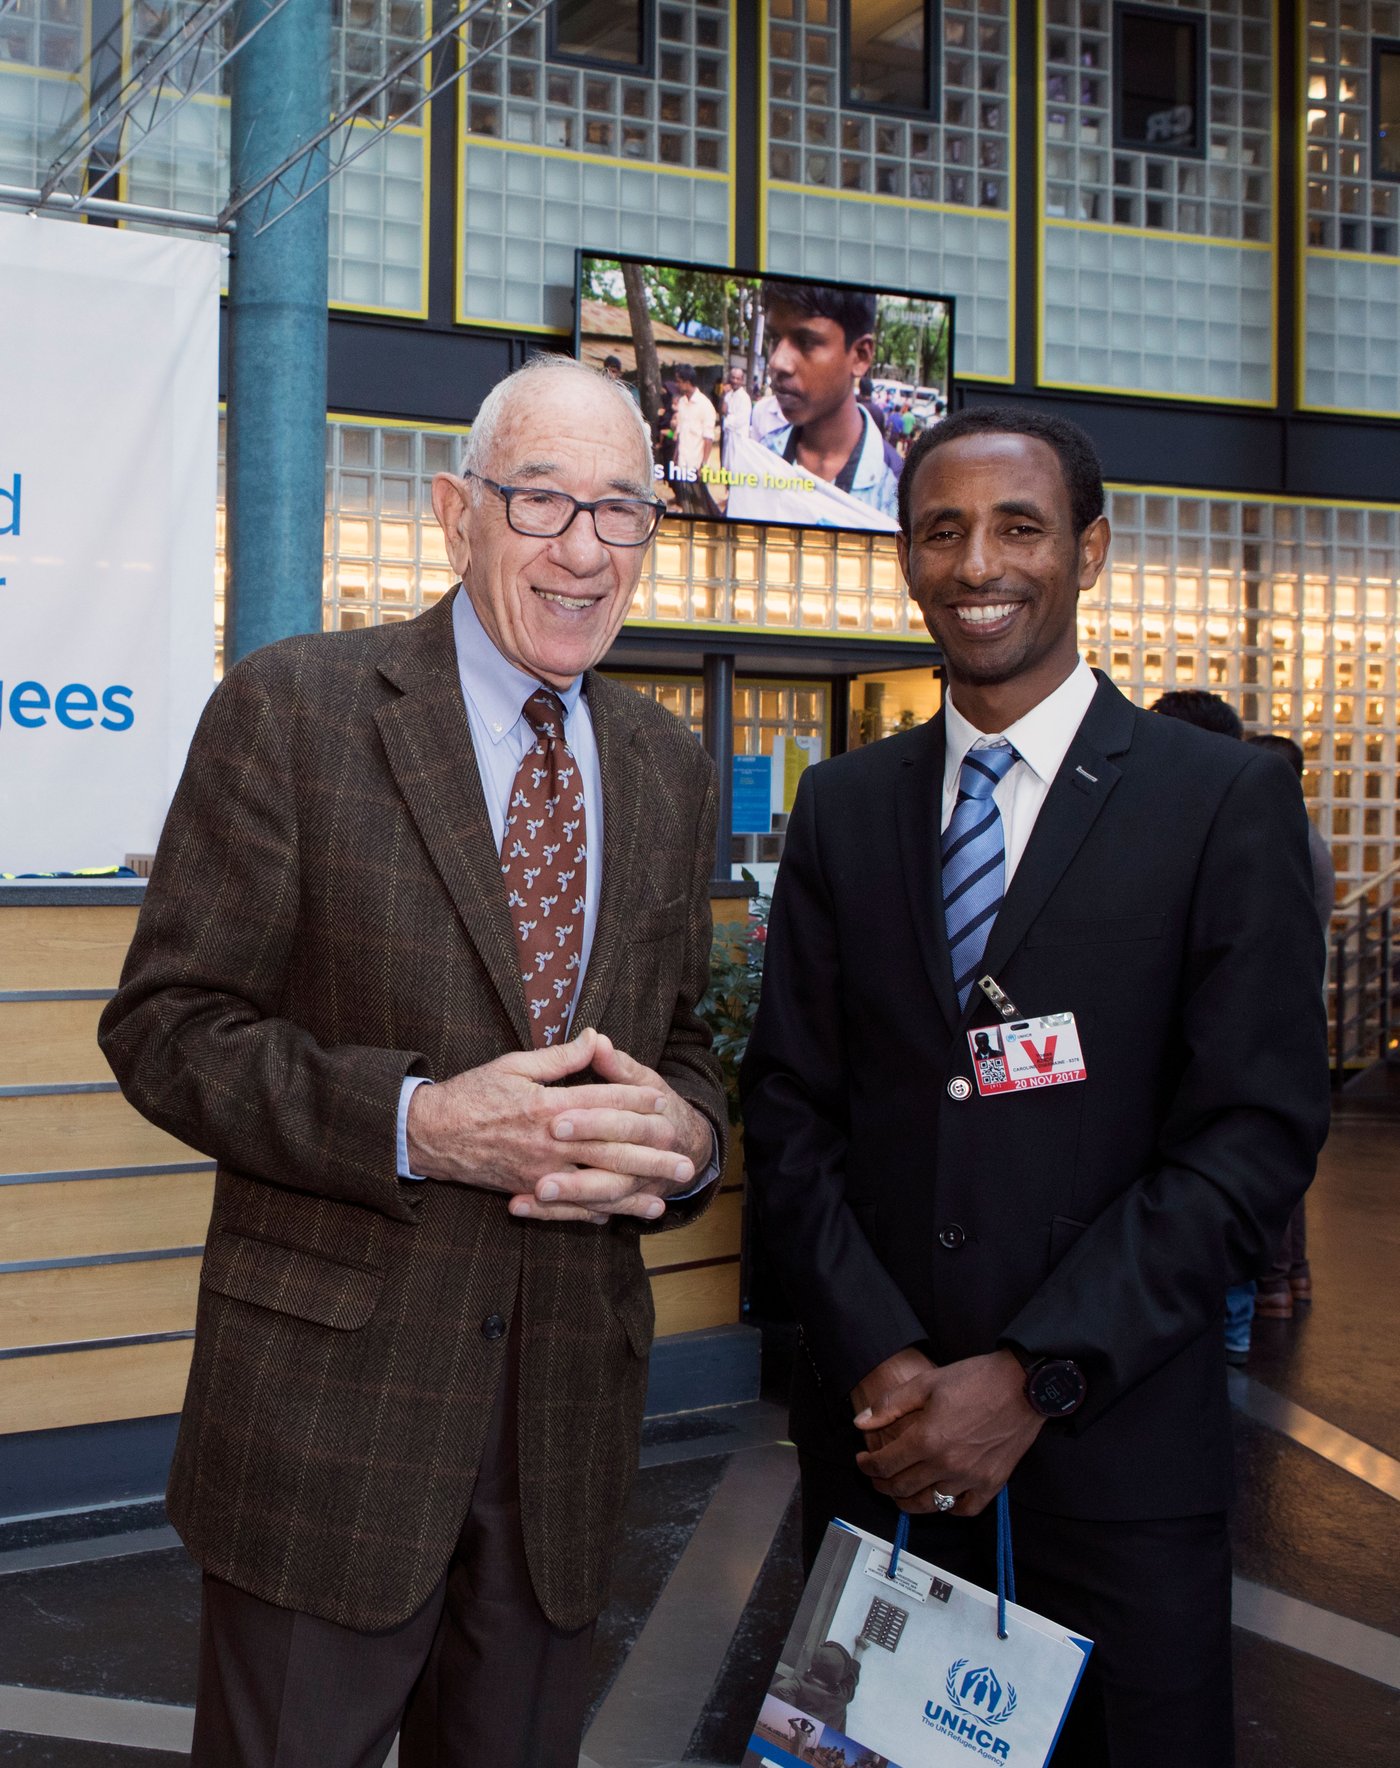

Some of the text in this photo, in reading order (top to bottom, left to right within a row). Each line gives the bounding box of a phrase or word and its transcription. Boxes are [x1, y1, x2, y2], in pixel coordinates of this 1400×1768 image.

[669, 461, 698, 482] his
[701, 465, 757, 486] future
[763, 471, 815, 491] home
[0, 680, 135, 732] ees
[1020, 1035, 1057, 1073] V
[1014, 1080, 1027, 1089] 20
[1030, 1075, 1053, 1087] NOV
[1056, 1070, 1080, 1081] 2017
[921, 1715, 1005, 1767] The UN Refugee Agency
[924, 1699, 1011, 1760] UNHCR
